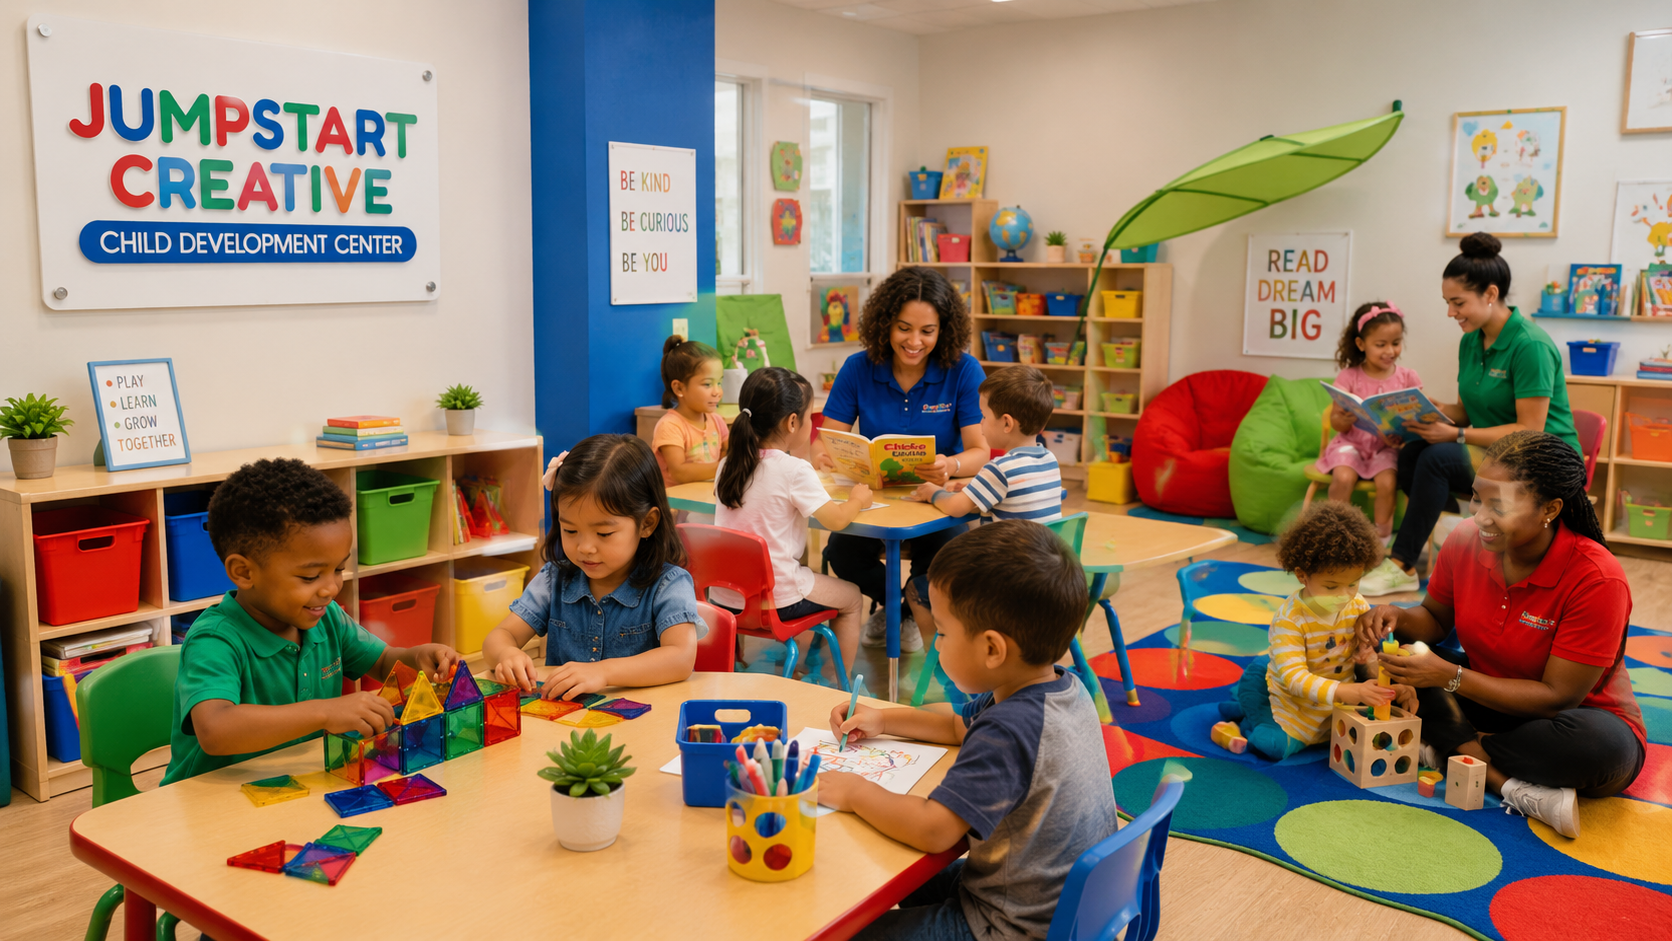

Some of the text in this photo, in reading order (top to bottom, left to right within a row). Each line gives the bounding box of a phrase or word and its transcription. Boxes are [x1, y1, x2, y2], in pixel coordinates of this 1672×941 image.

[68, 82, 418, 159] JUMPSTART
[110, 154, 393, 214] CREATIVE
[620, 170, 671, 193] BE KIND
[621, 211, 689, 233] BE CURIOUS
[99, 230, 403, 255] CHILD DEVELOPMENT CENTER
[622, 252, 668, 273] BE YOU
[1267, 249, 1329, 273] READ
[1257, 279, 1336, 304] DREAM
[1269, 308, 1322, 341] BIG
[116, 374, 144, 389] PLAY
[120, 394, 157, 410] LEARN
[124, 415, 157, 431] GROW
[117, 433, 177, 452] TOGETHER
